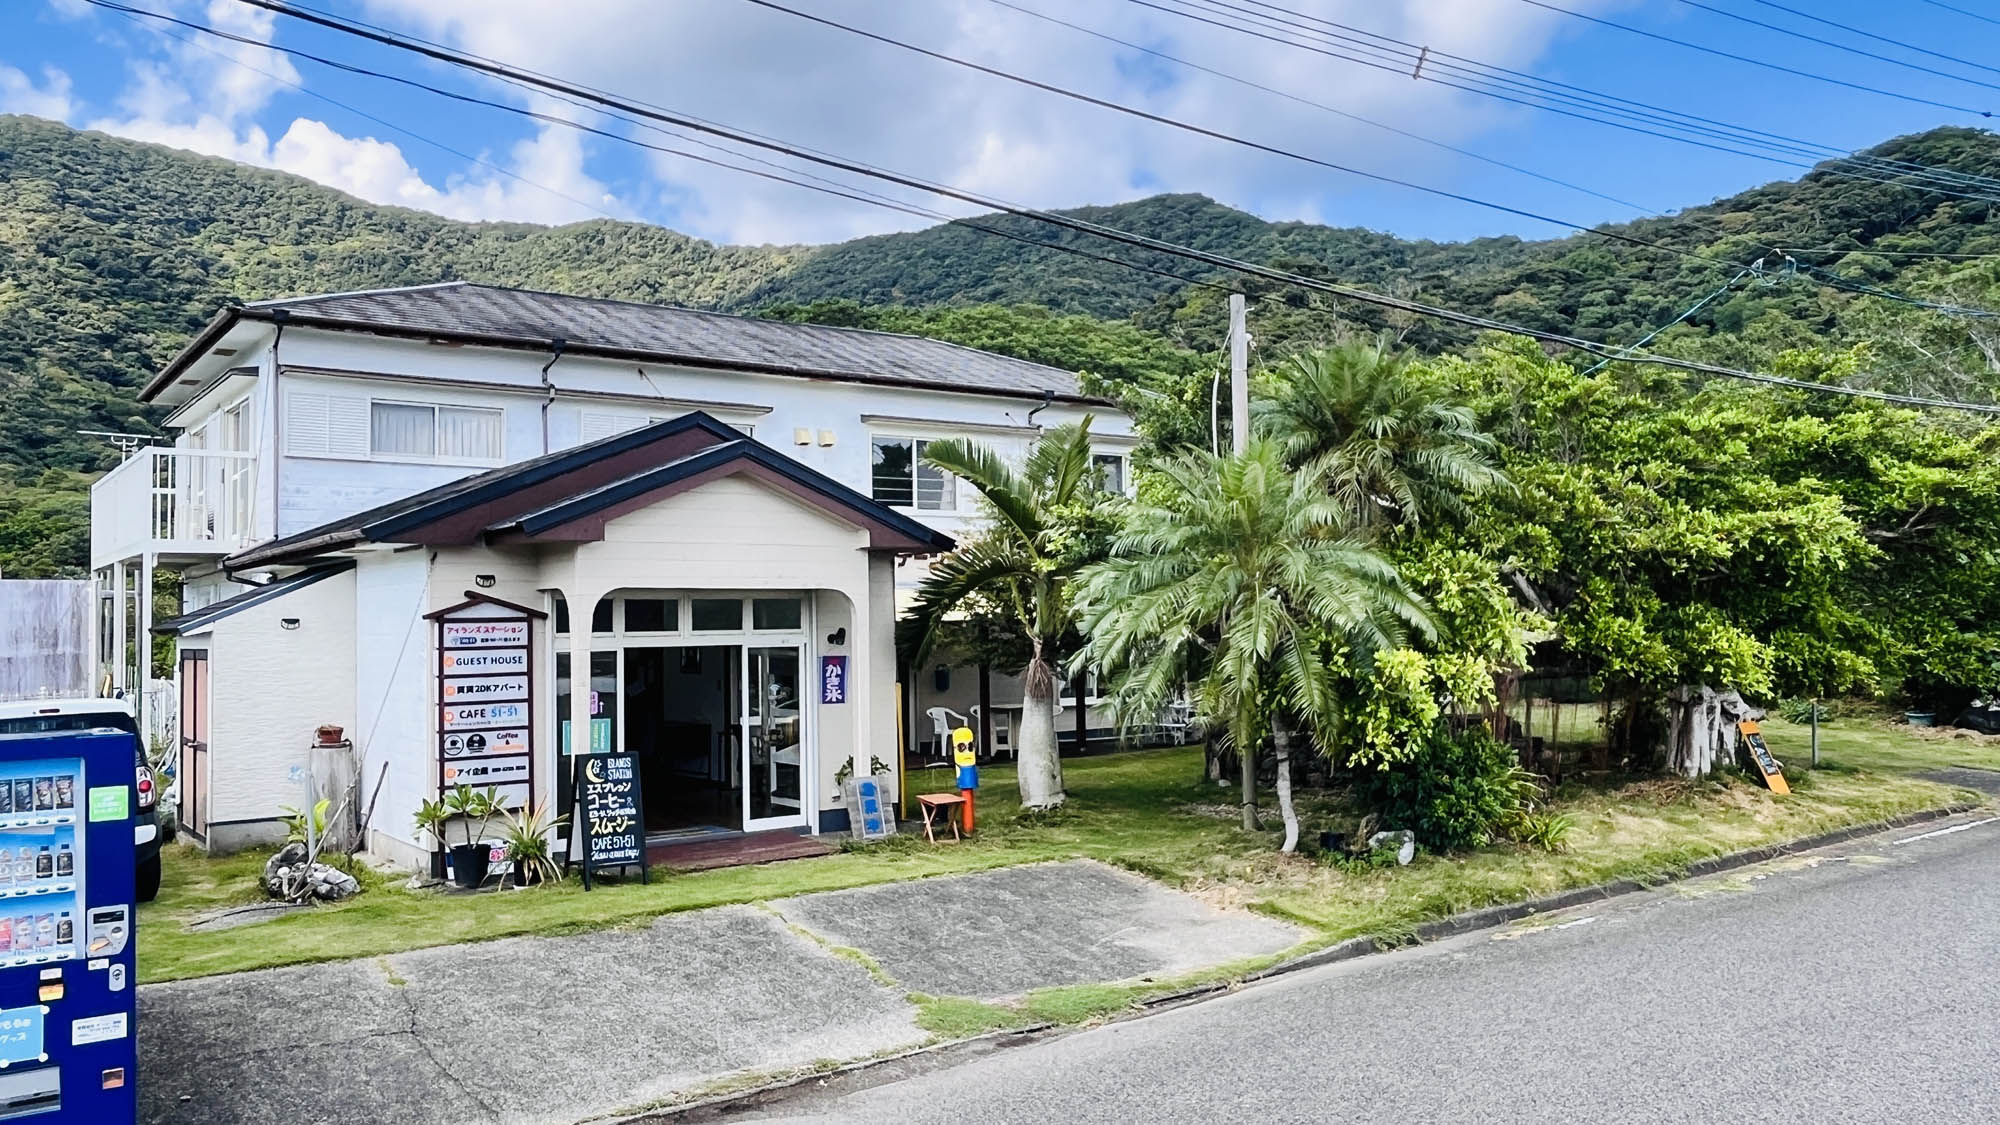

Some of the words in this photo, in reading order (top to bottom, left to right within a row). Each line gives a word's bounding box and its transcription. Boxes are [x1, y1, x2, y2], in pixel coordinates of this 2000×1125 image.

[456, 656, 488, 665] GUEST
[490, 656, 524, 665] HOUSE
[825, 664, 843, 702] かき氷
[459, 708, 486, 719] CAFE
[587, 793, 625, 809] コーヒー
[589, 816, 636, 836] スムージー
